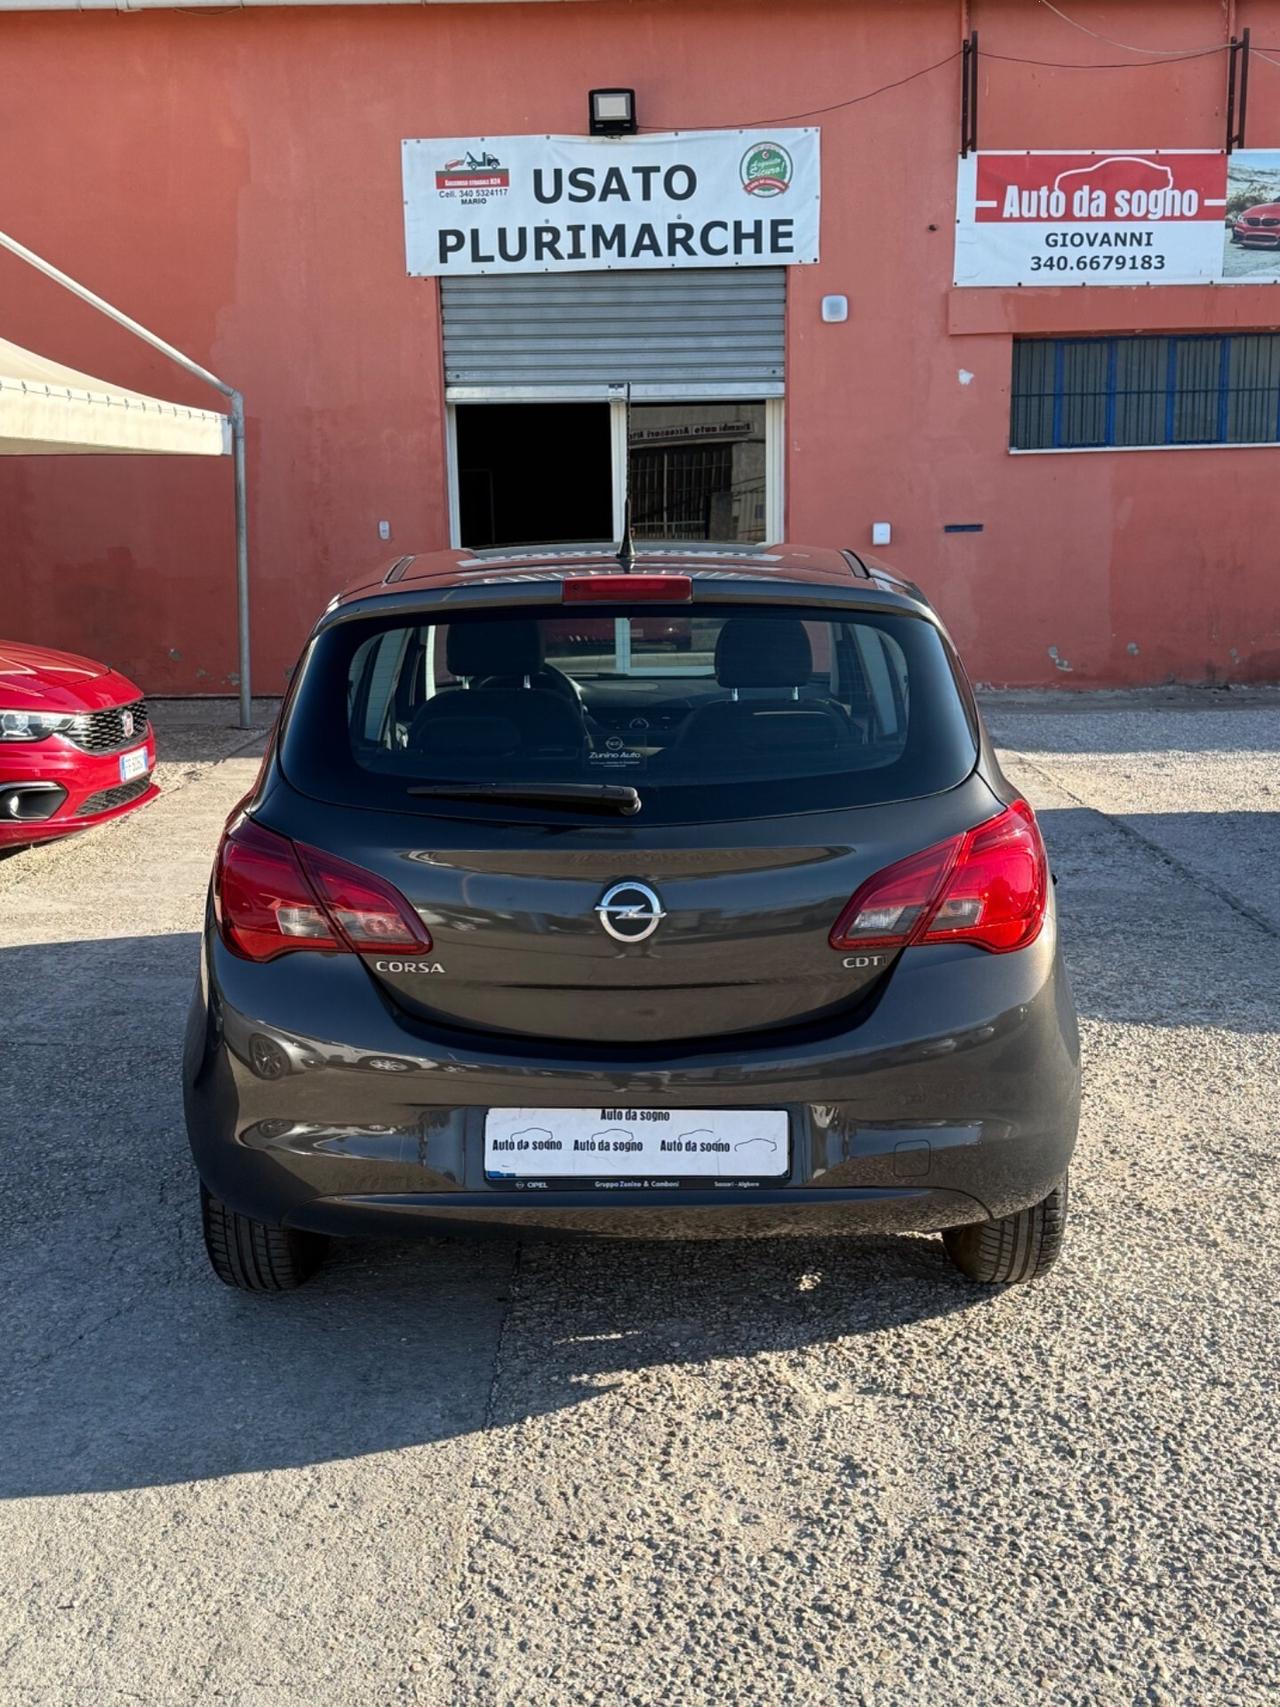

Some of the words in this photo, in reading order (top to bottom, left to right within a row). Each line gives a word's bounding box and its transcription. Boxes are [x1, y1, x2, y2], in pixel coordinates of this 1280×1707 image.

[533, 164, 697, 204] USATO
[439, 190, 457, 198] Cell.
[459, 190, 474, 198] 340
[475, 188, 508, 197] 5324117
[460, 197, 487, 205] MARIO
[1002, 185, 1066, 218] Auto
[1073, 185, 1106, 218] da
[1114, 188, 1199, 220] sogno
[437, 218, 795, 264] PLURIMARCHE
[1044, 231, 1154, 249] GIOVANNI
[1030, 254, 1166, 271] 340.6679183
[375, 960, 446, 973] CORSA
[600, 1108, 623, 1121] Auto
[625, 1108, 638, 1121] da
[639, 1110, 670, 1122] sogno
[492, 1139, 515, 1151] Auto
[516, 1139, 530, 1151] da
[573, 1139, 596, 1151] Auto
[597, 1139, 611, 1152] da
[612, 1141, 644, 1153] sogno
[660, 1139, 683, 1152] Auto
[684, 1140, 698, 1152] da
[526, 1181, 549, 1189] OPEL
[594, 1181, 619, 1189] Gruppo
[643, 1180, 650, 1188] &
